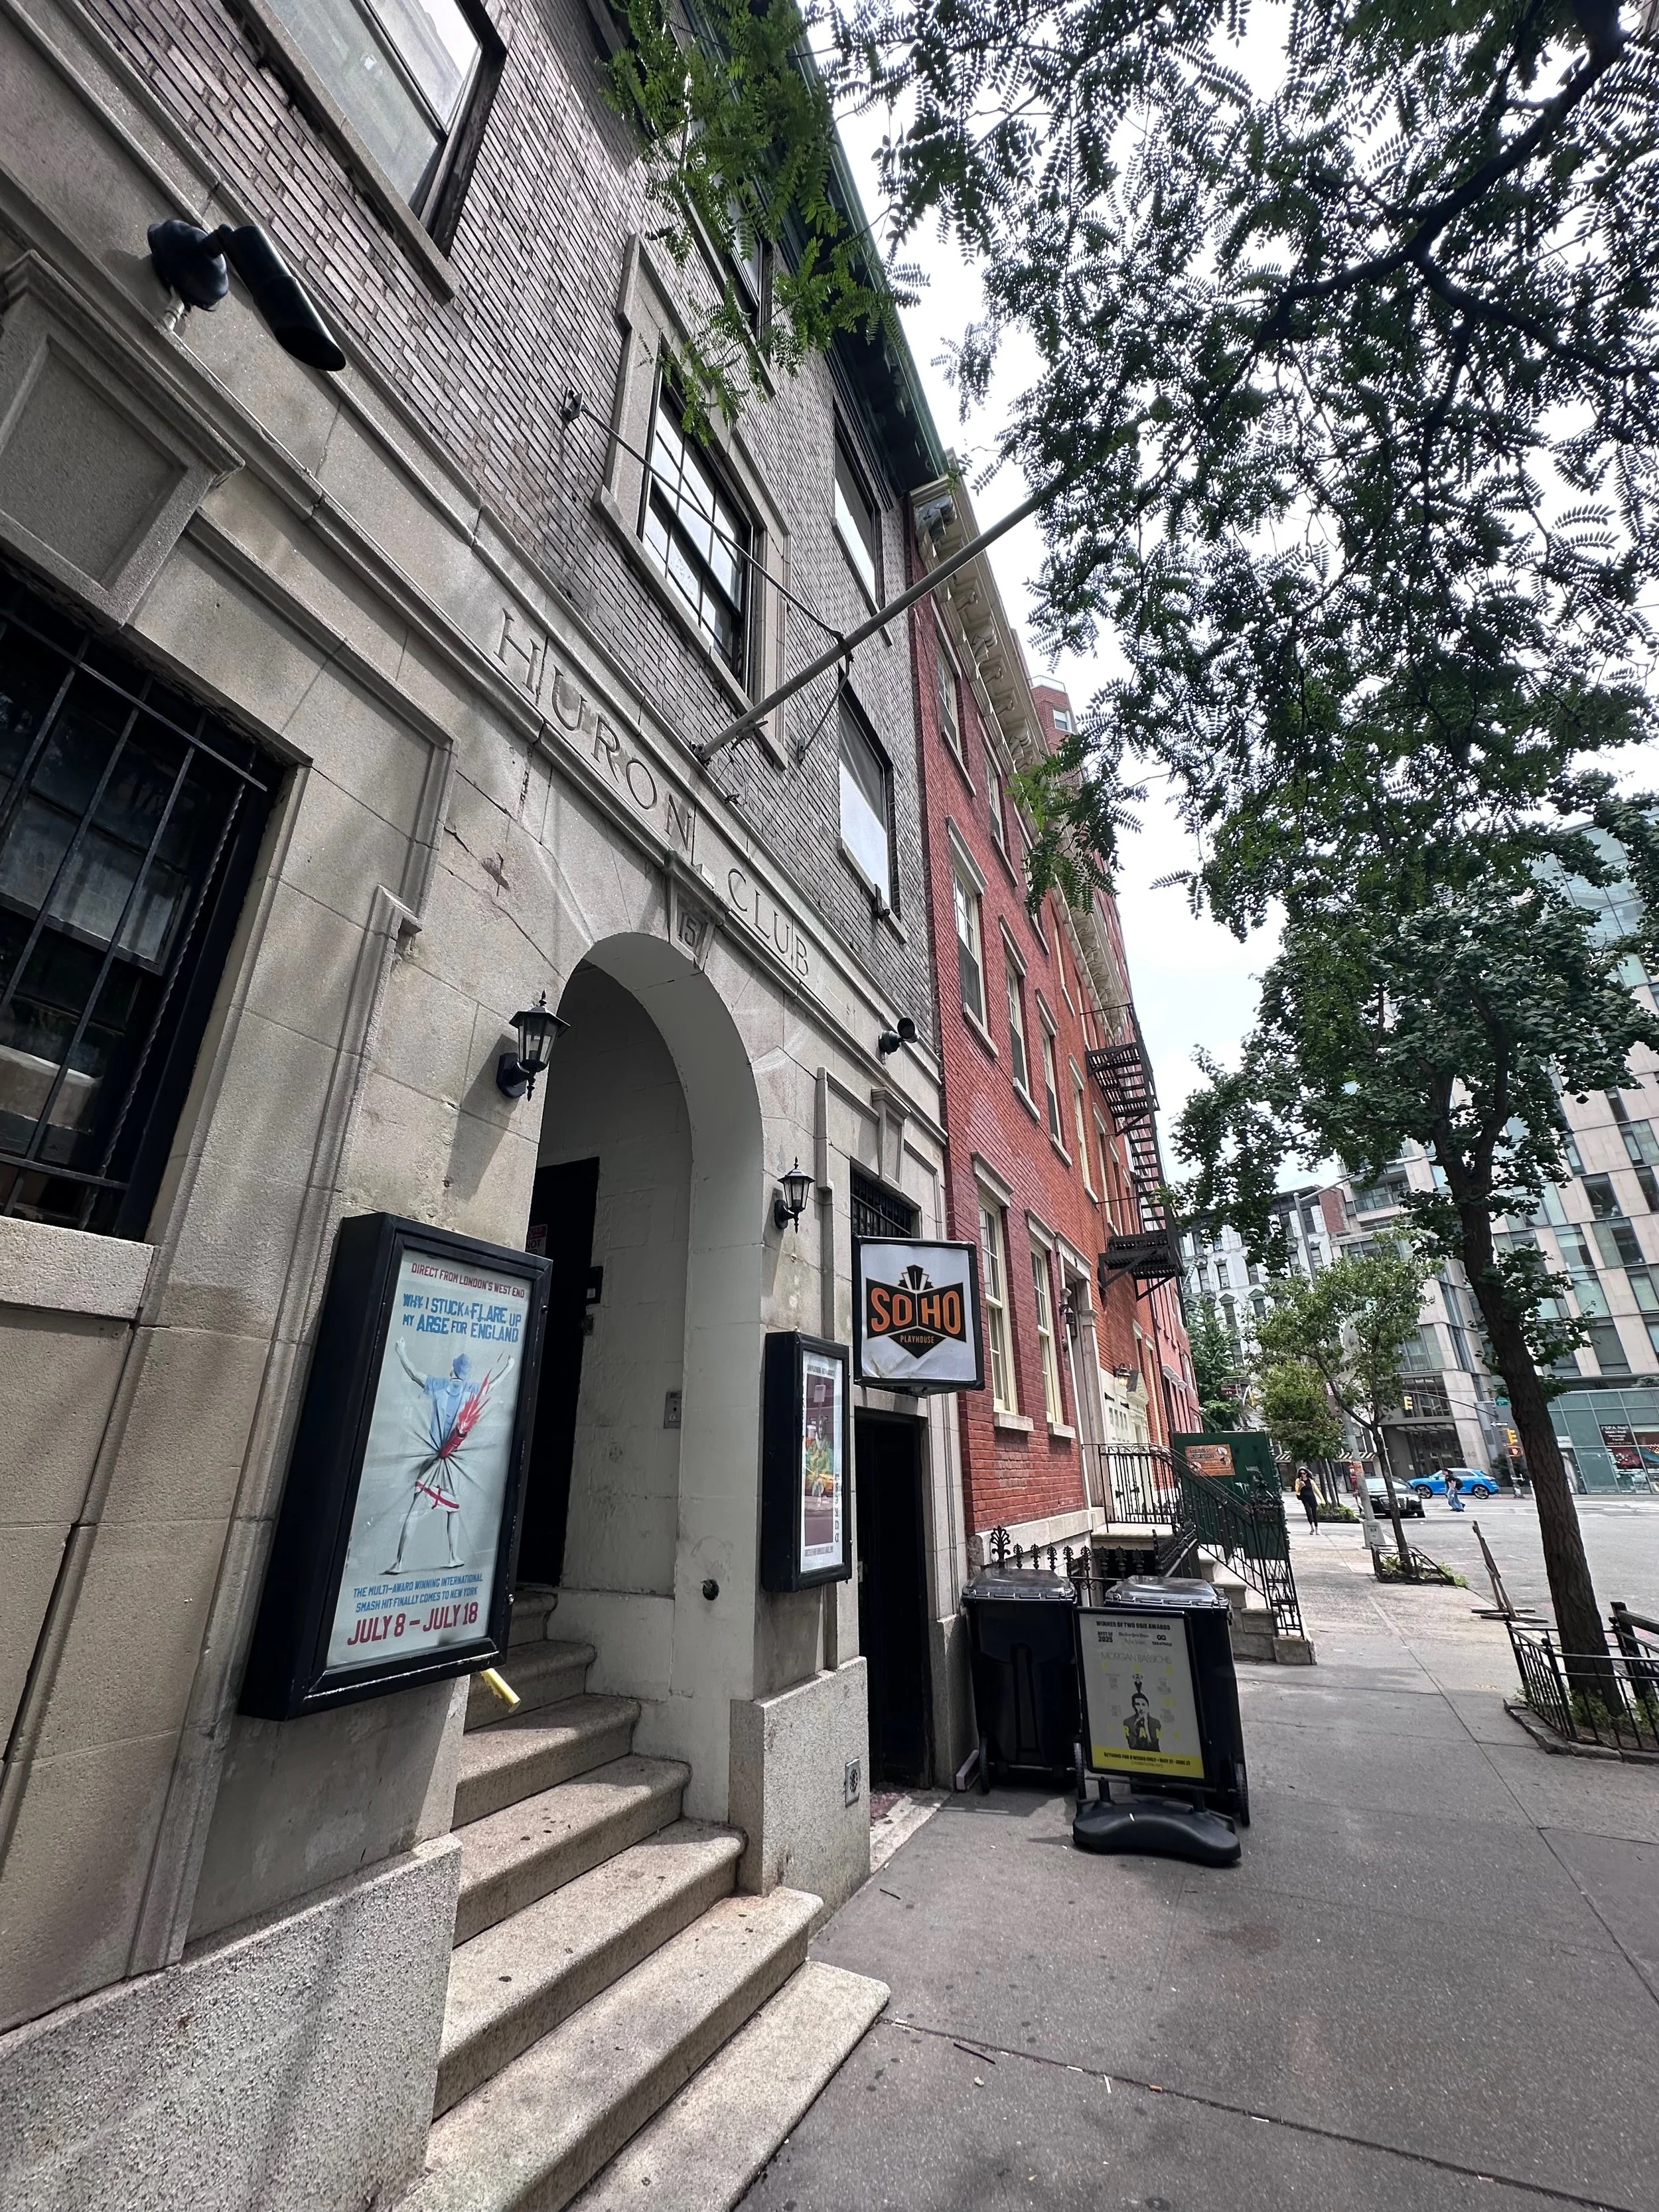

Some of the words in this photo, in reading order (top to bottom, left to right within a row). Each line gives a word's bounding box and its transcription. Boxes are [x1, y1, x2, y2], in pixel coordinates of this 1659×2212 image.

[494, 607, 692, 851] HURON
[728, 868, 808, 976] CLUB
[411, 1263, 439, 1278] DIRECT
[439, 1270, 459, 1284] FROM
[459, 1276, 494, 1291] LONDON'S
[494, 1284, 512, 1295] WEST
[512, 1288, 525, 1298] END
[403, 1293, 423, 1309] WHY
[425, 1297, 429, 1309] I
[431, 1297, 465, 1317] STUCK
[465, 1305, 469, 1316] A
[470, 1303, 508, 1323] FLARE
[509, 1313, 522, 1327] UP
[871, 1288, 961, 1335] SOHO
[402, 1314, 415, 1326] MY
[416, 1314, 450, 1335] ARSE
[451, 1321, 467, 1334] FOR
[470, 1323, 519, 1343] ENGLAND
[901, 1335, 934, 1344] PLAYHOUSE
[353, 1587, 368, 1598] THE
[368, 1582, 413, 1596] MULTI-AWARD
[415, 1578, 440, 1590] WINNING
[441, 1573, 483, 1586] INTERNATIONAL
[356, 1601, 380, 1613] SMASH
[381, 1598, 395, 1609] HIT
[394, 1595, 419, 1607] FINALLY
[419, 1591, 441, 1603] COMES
[442, 1591, 450, 1600] TO
[450, 1589, 465, 1599] NEW
[464, 1586, 478, 1595] YORK
[348, 1615, 392, 1645] JULY
[394, 1613, 406, 1637] 8
[423, 1604, 461, 1632] JULY
[463, 1601, 478, 1625] 18
